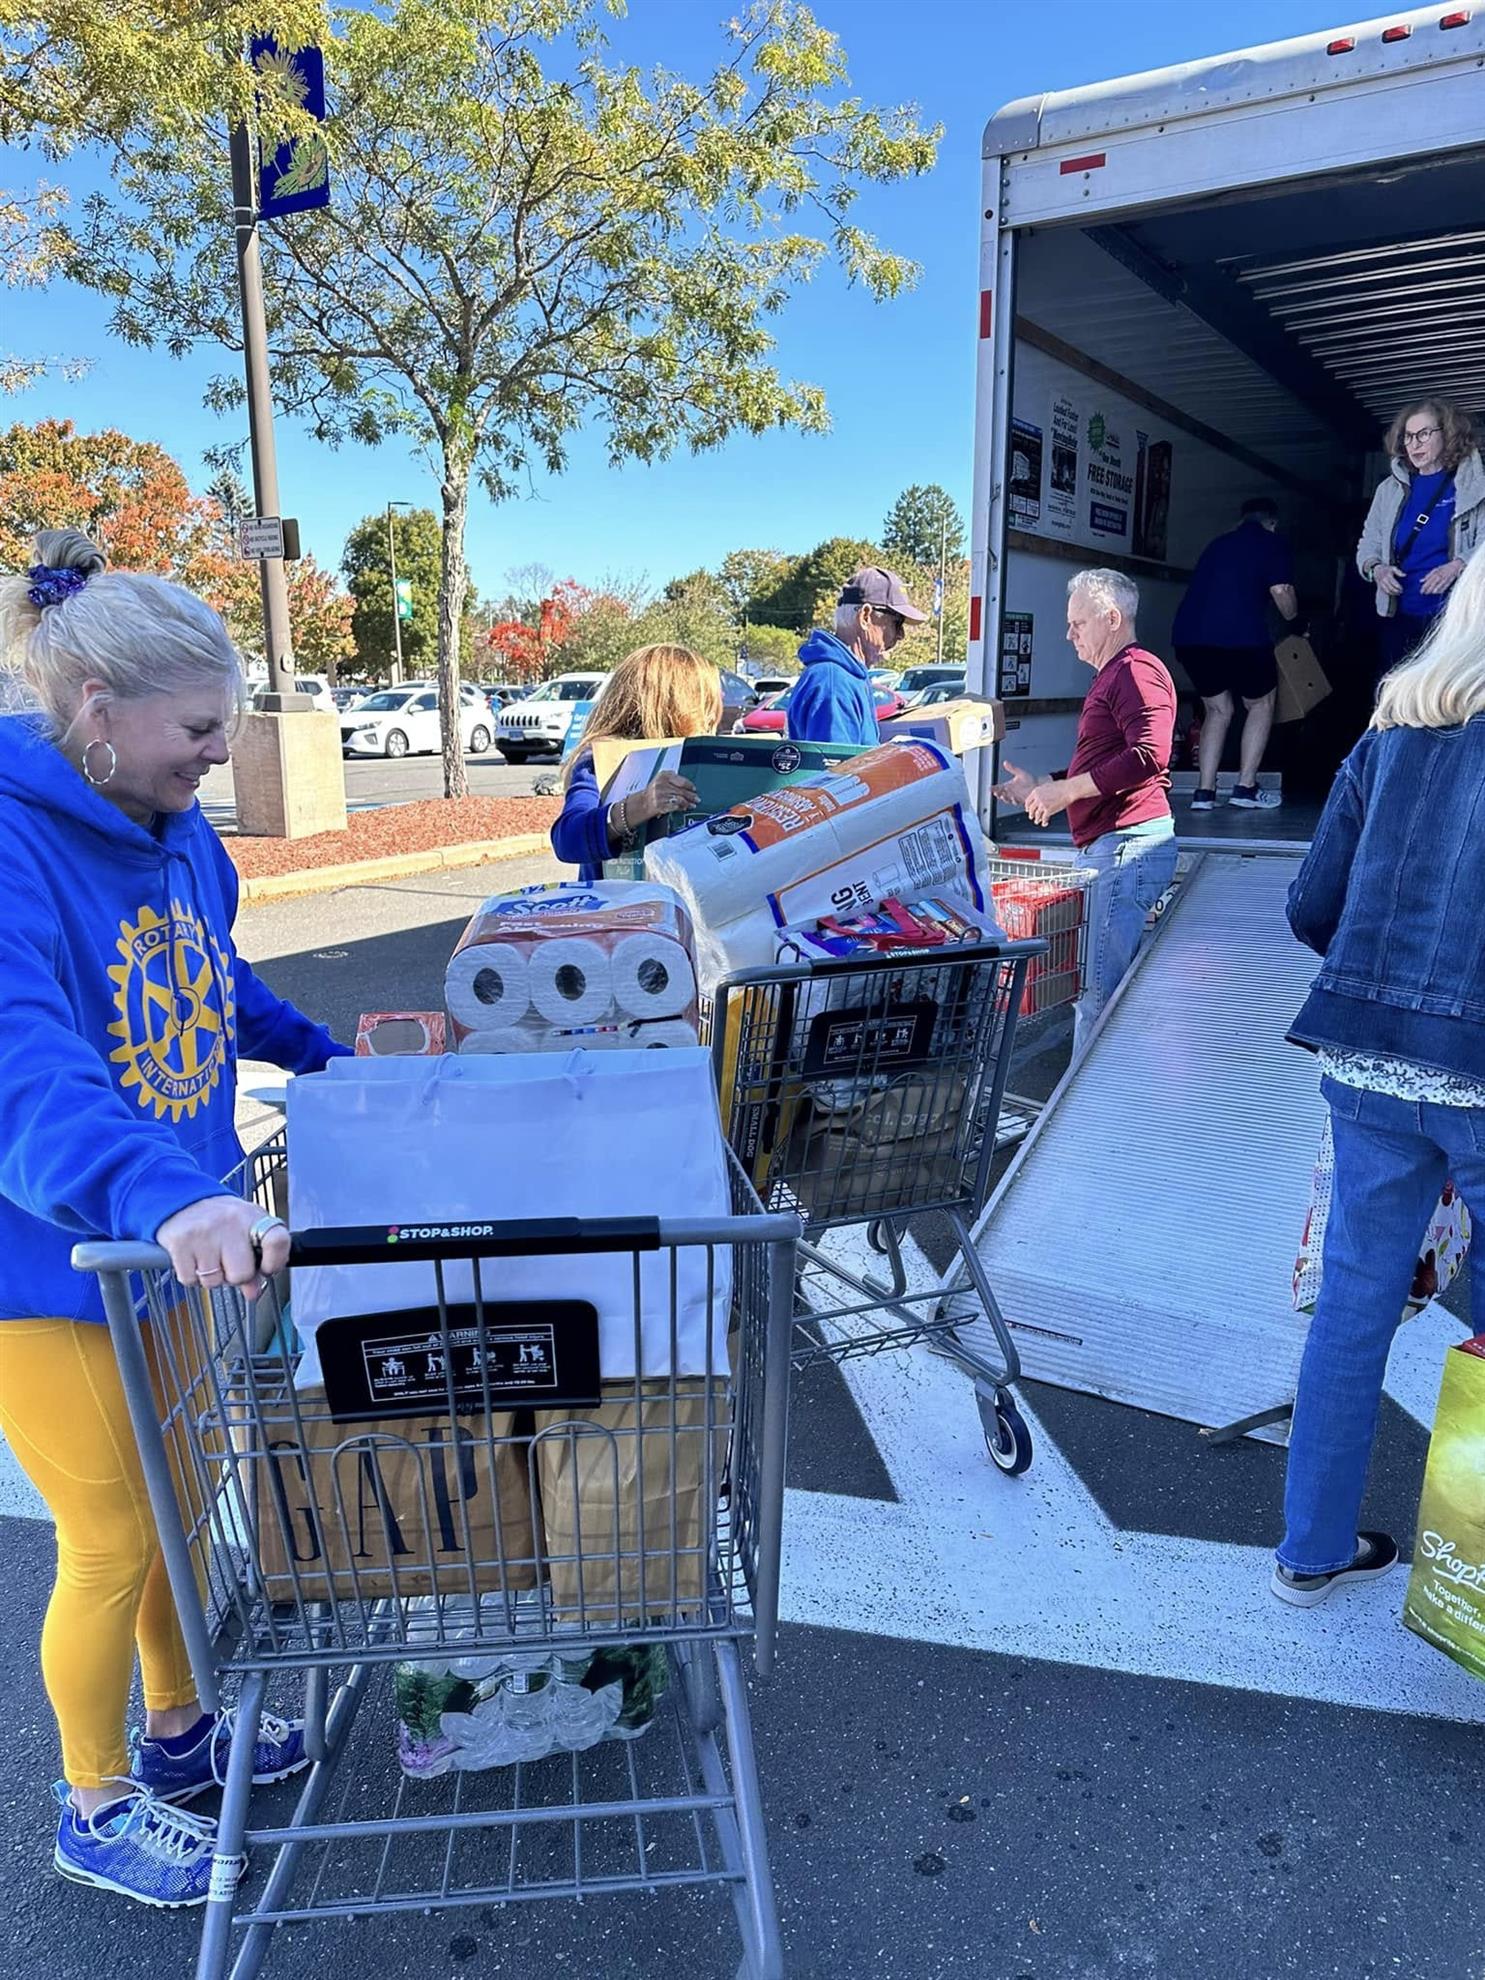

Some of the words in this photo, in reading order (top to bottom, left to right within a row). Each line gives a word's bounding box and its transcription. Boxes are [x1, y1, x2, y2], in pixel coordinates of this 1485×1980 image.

[1087, 462, 1105, 485] FREE
[1105, 468, 1134, 494] STORAGE
[505, 895, 594, 916] Scott
[748, 1104, 763, 1133] SMALL
[745, 1134, 759, 1158] DOG
[267, 1426, 479, 1562] GAP
[1433, 1579, 1482, 1618] Together,
